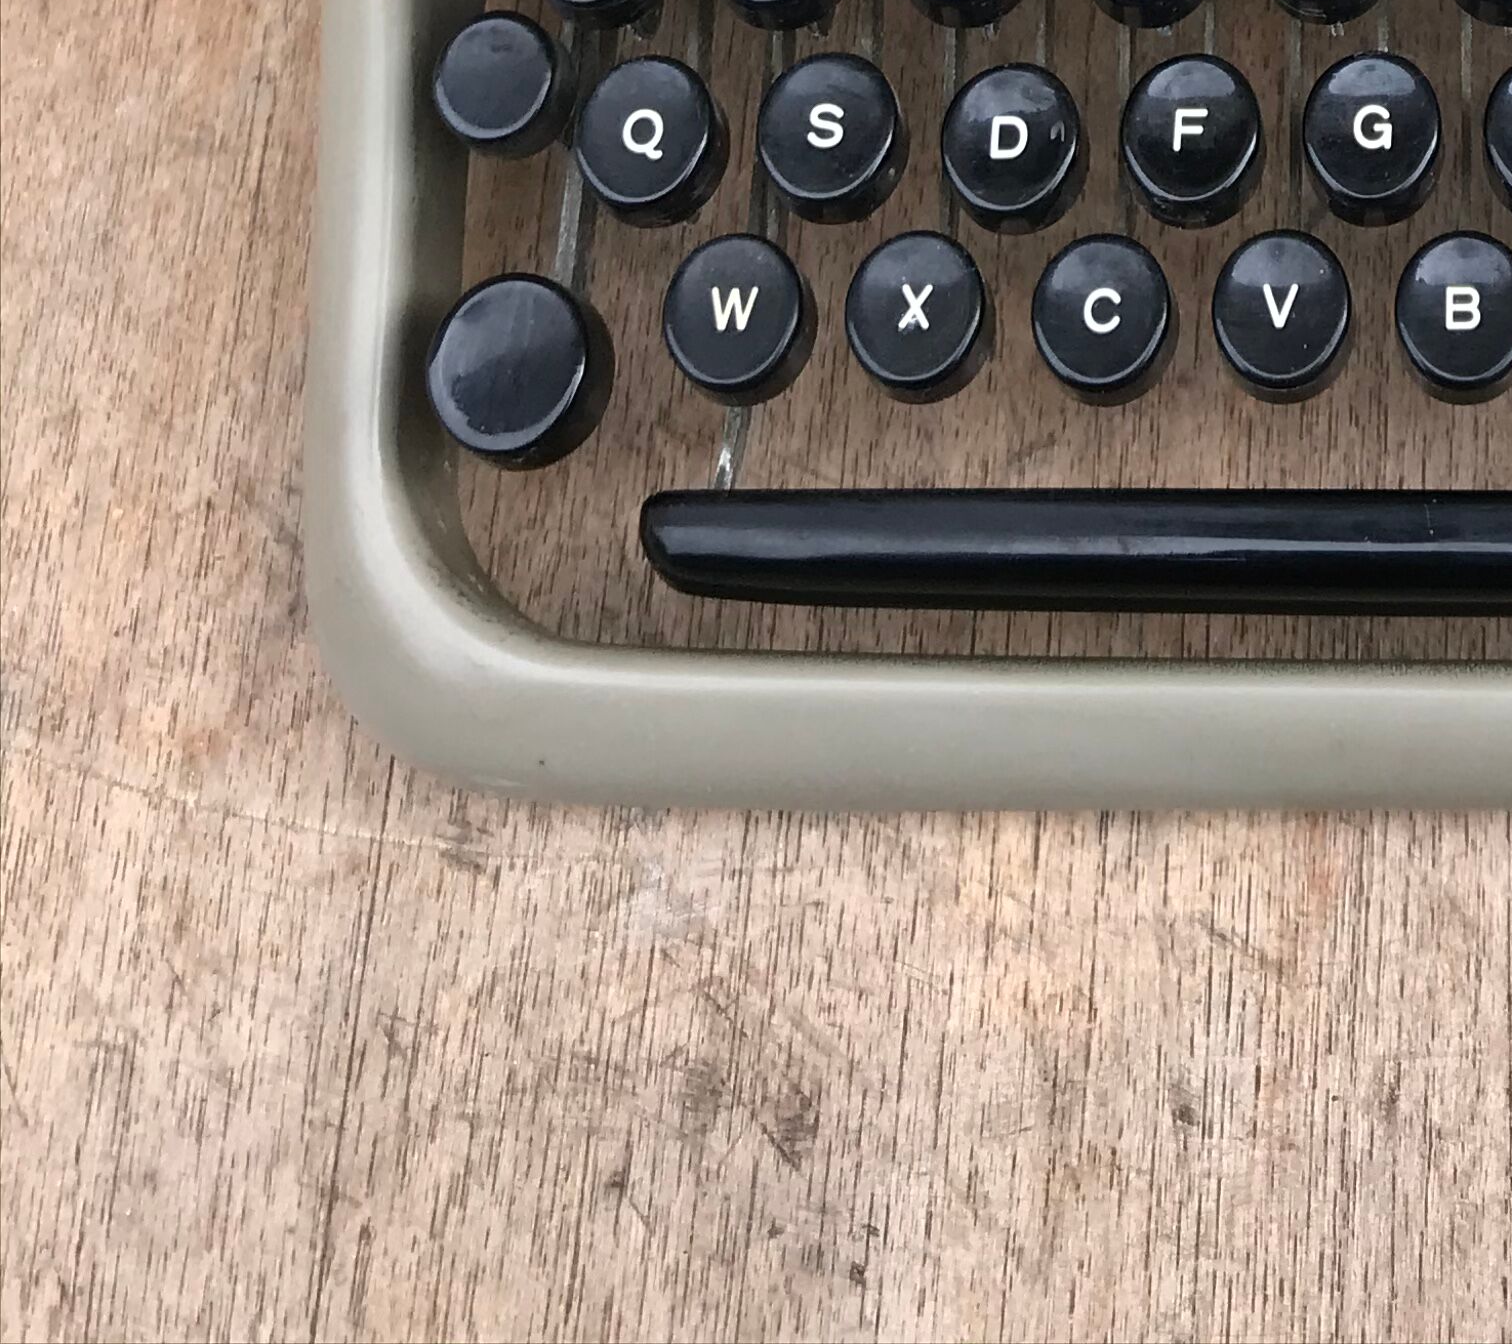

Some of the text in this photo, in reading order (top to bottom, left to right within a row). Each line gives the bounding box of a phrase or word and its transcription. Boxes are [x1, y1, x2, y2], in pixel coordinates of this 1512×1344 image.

[622, 108, 664, 160] Q
[807, 103, 845, 148] S
[989, 115, 1028, 159] D
[1172, 108, 1209, 152] F
[1353, 104, 1393, 150] G
[711, 286, 759, 331] W
[898, 283, 934, 330] X
[1083, 287, 1122, 334] C
[1262, 282, 1299, 328] V
[1445, 285, 1481, 330] B
